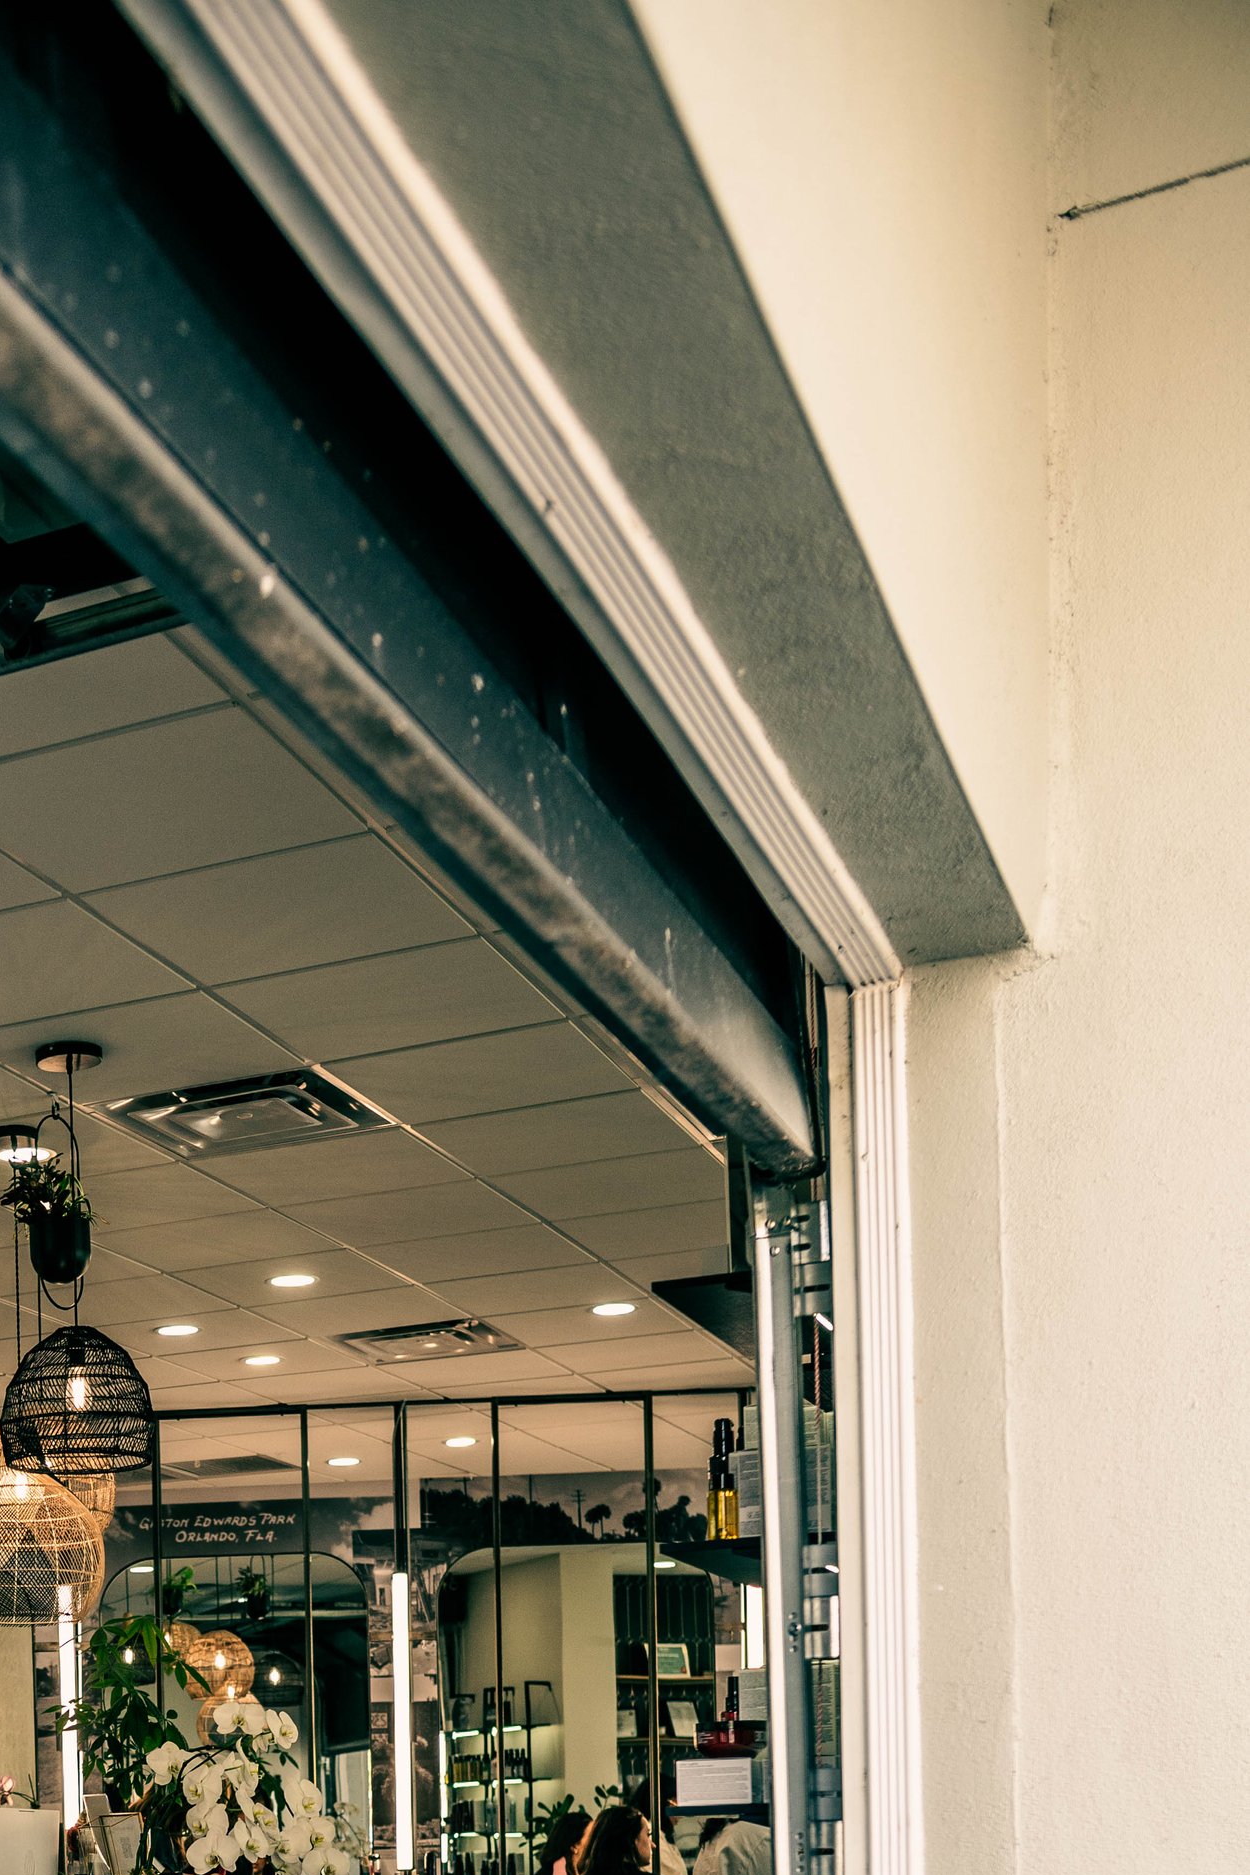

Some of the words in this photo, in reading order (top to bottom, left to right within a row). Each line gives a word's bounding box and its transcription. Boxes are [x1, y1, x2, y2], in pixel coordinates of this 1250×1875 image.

[139, 1517, 190, 1530] GTON
[194, 1515, 257, 1527] EDWARDS
[259, 1513, 296, 1525] PARK
[175, 1531, 239, 1543] ORLANDO,
[244, 1530, 278, 1543] FLA.
